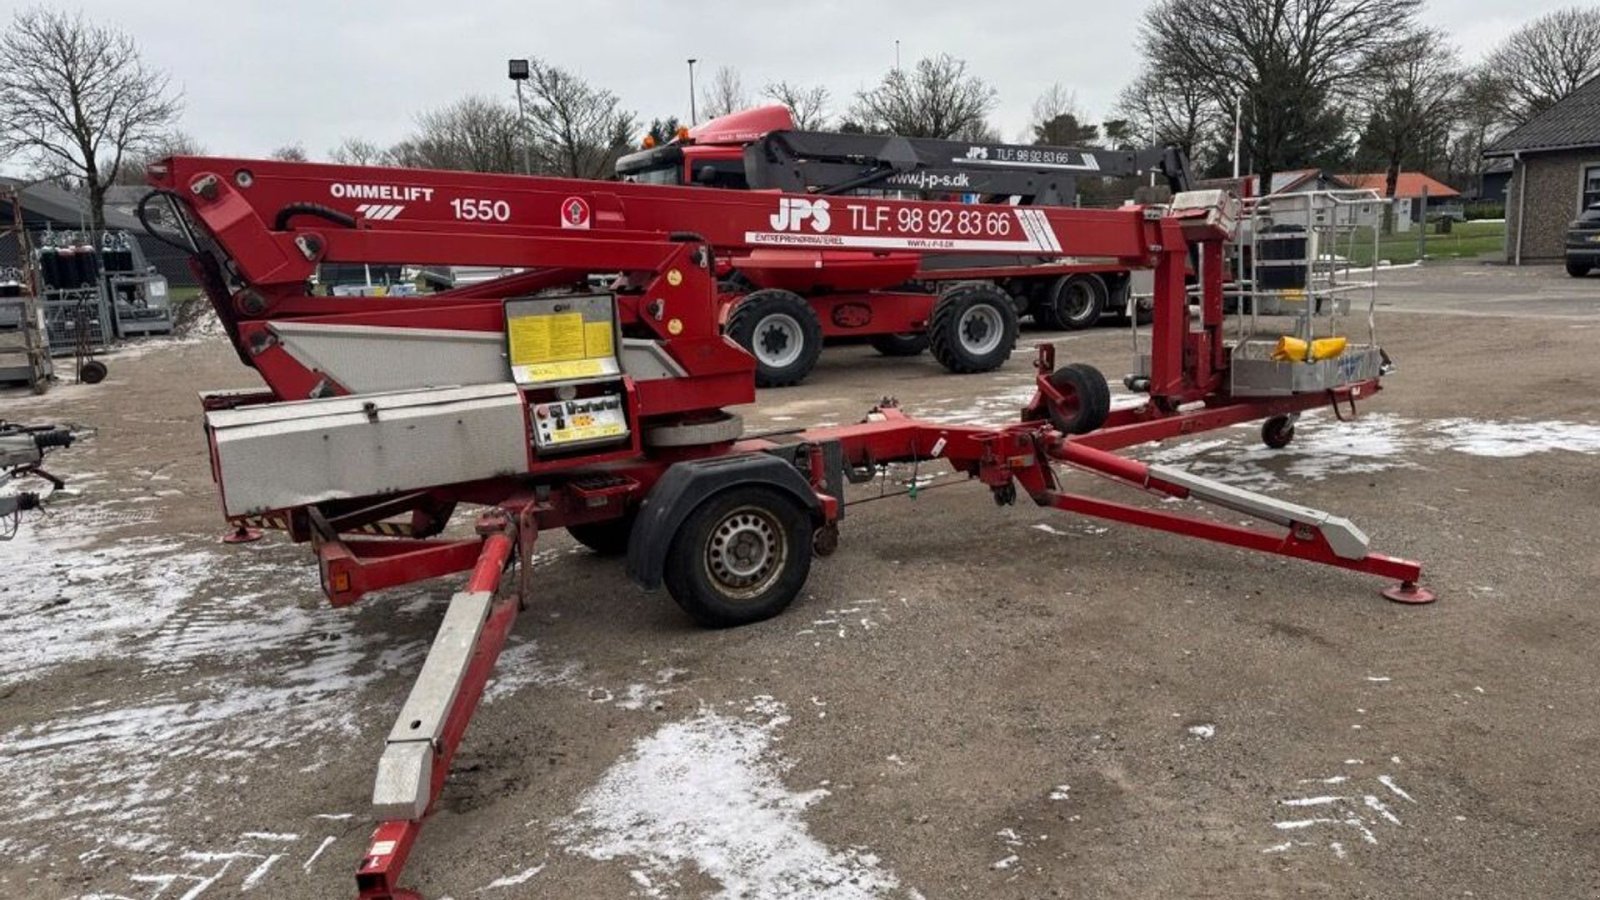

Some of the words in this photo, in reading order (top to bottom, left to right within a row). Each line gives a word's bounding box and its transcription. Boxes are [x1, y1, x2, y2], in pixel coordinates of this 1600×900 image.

[966, 147, 988, 159] JPS
[995, 149, 1015, 161] TLF.
[1016, 149, 1029, 162] 98
[1029, 150, 1042, 163] 92
[1043, 151, 1055, 163] 83
[1056, 152, 1069, 164] 66
[887, 171, 970, 189] www.j-p-s.dk
[330, 183, 435, 201] OMMELIFT
[450, 198, 510, 221] 1550
[769, 198, 831, 232] JPS
[847, 205, 893, 232] TLF.
[897, 207, 923, 233] 98
[928, 209, 953, 234] 92
[957, 210, 982, 235] 83
[986, 212, 1011, 236] 66
